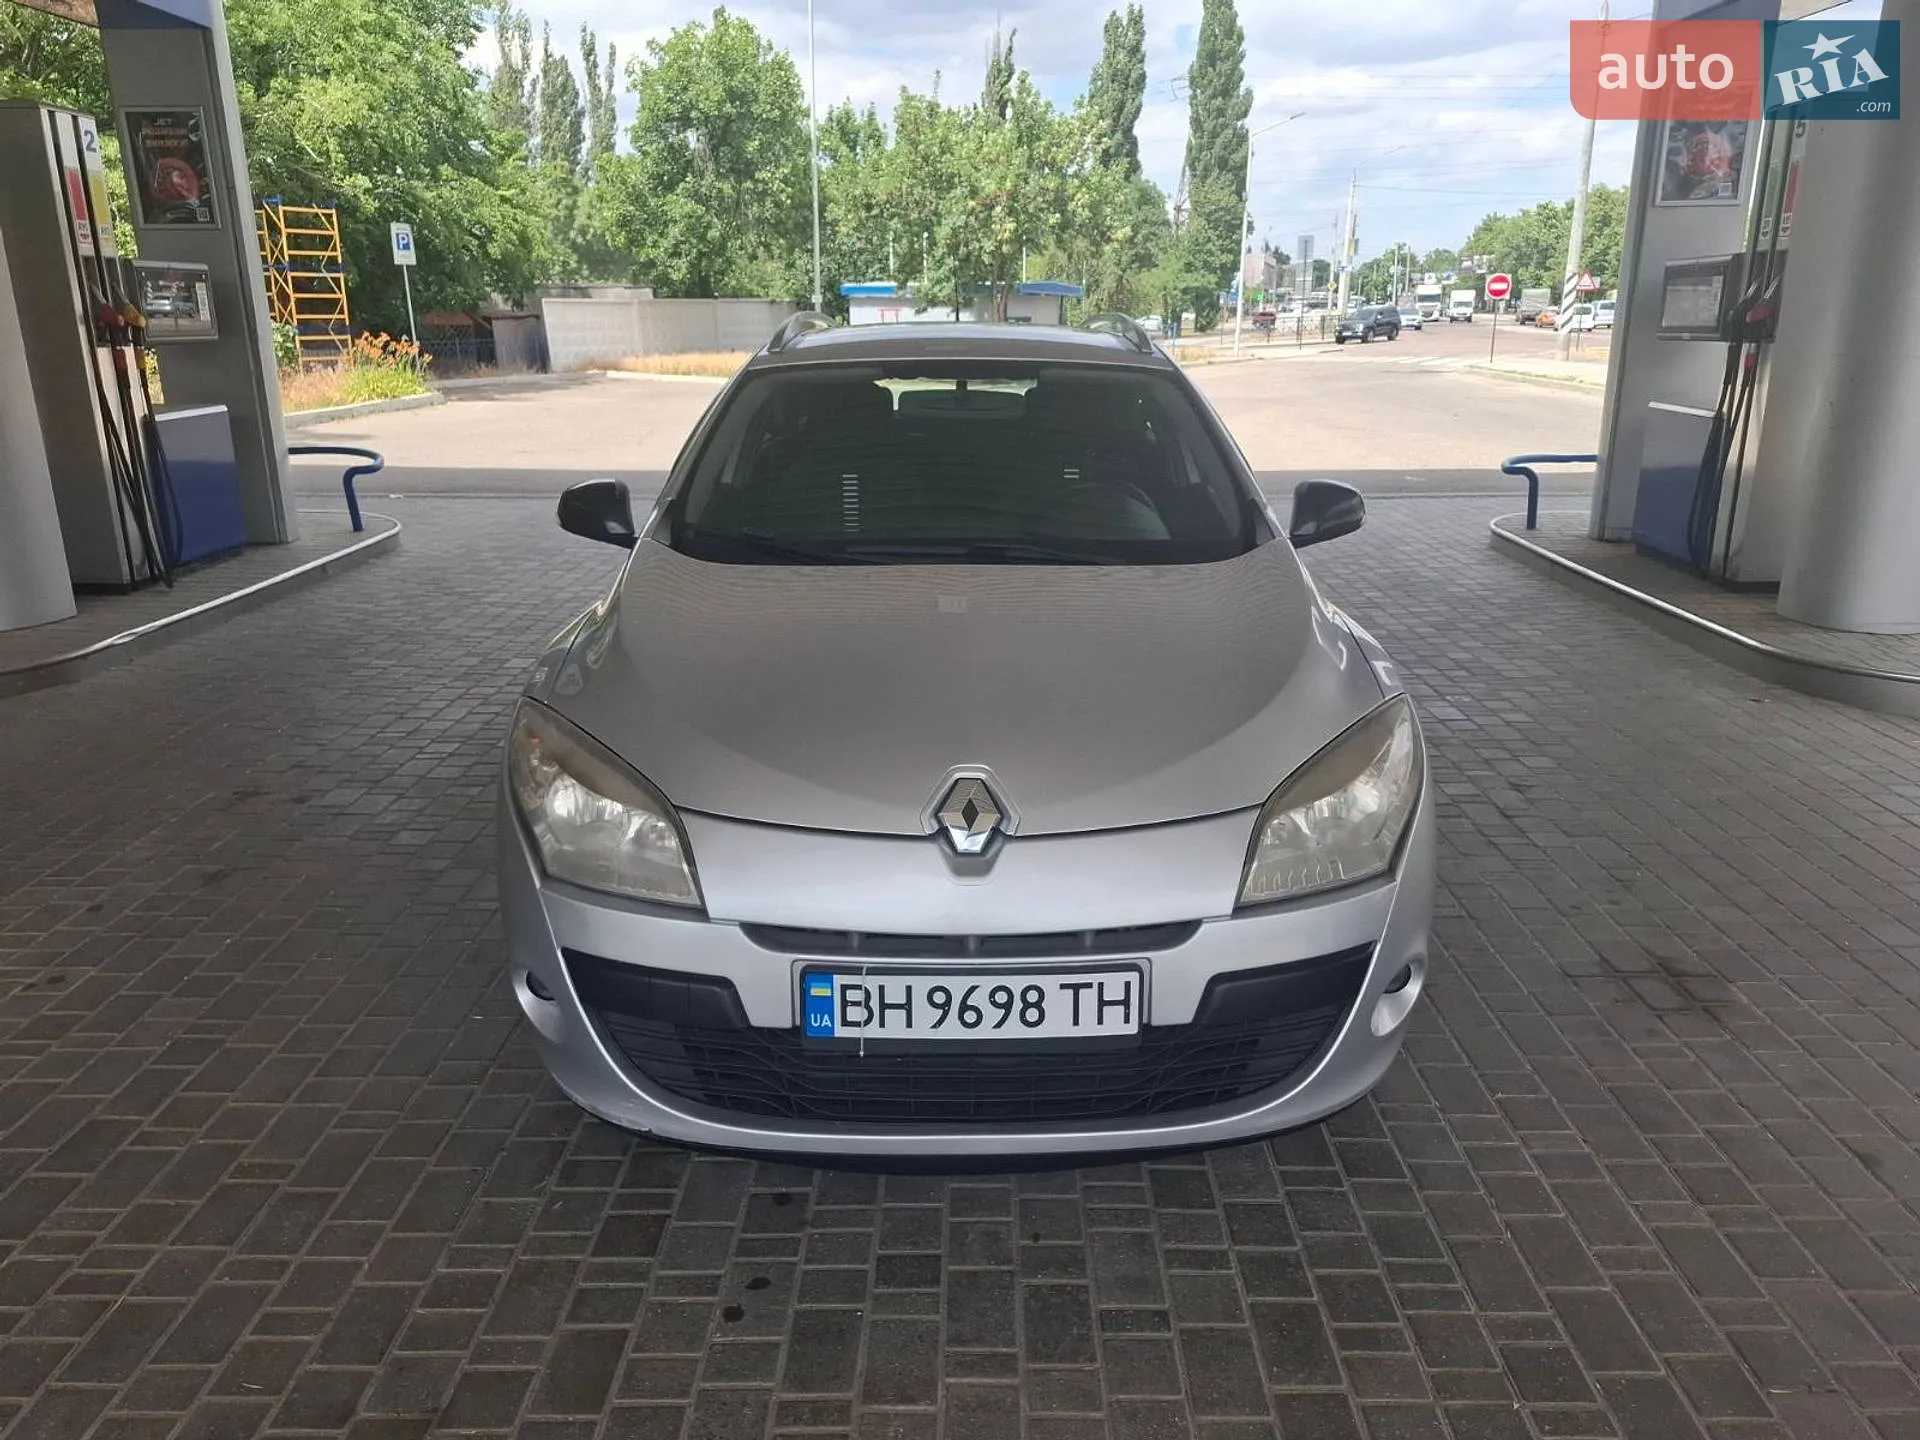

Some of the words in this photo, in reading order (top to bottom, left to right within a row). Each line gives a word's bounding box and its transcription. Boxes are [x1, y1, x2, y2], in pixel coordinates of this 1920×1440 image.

[84, 130, 97, 153] 2
[399, 234, 408, 249] P
[839, 984, 913, 1029] BH
[926, 984, 1046, 1029] 9698
[1059, 980, 1131, 1026] TH
[810, 1012, 832, 1027] UA
